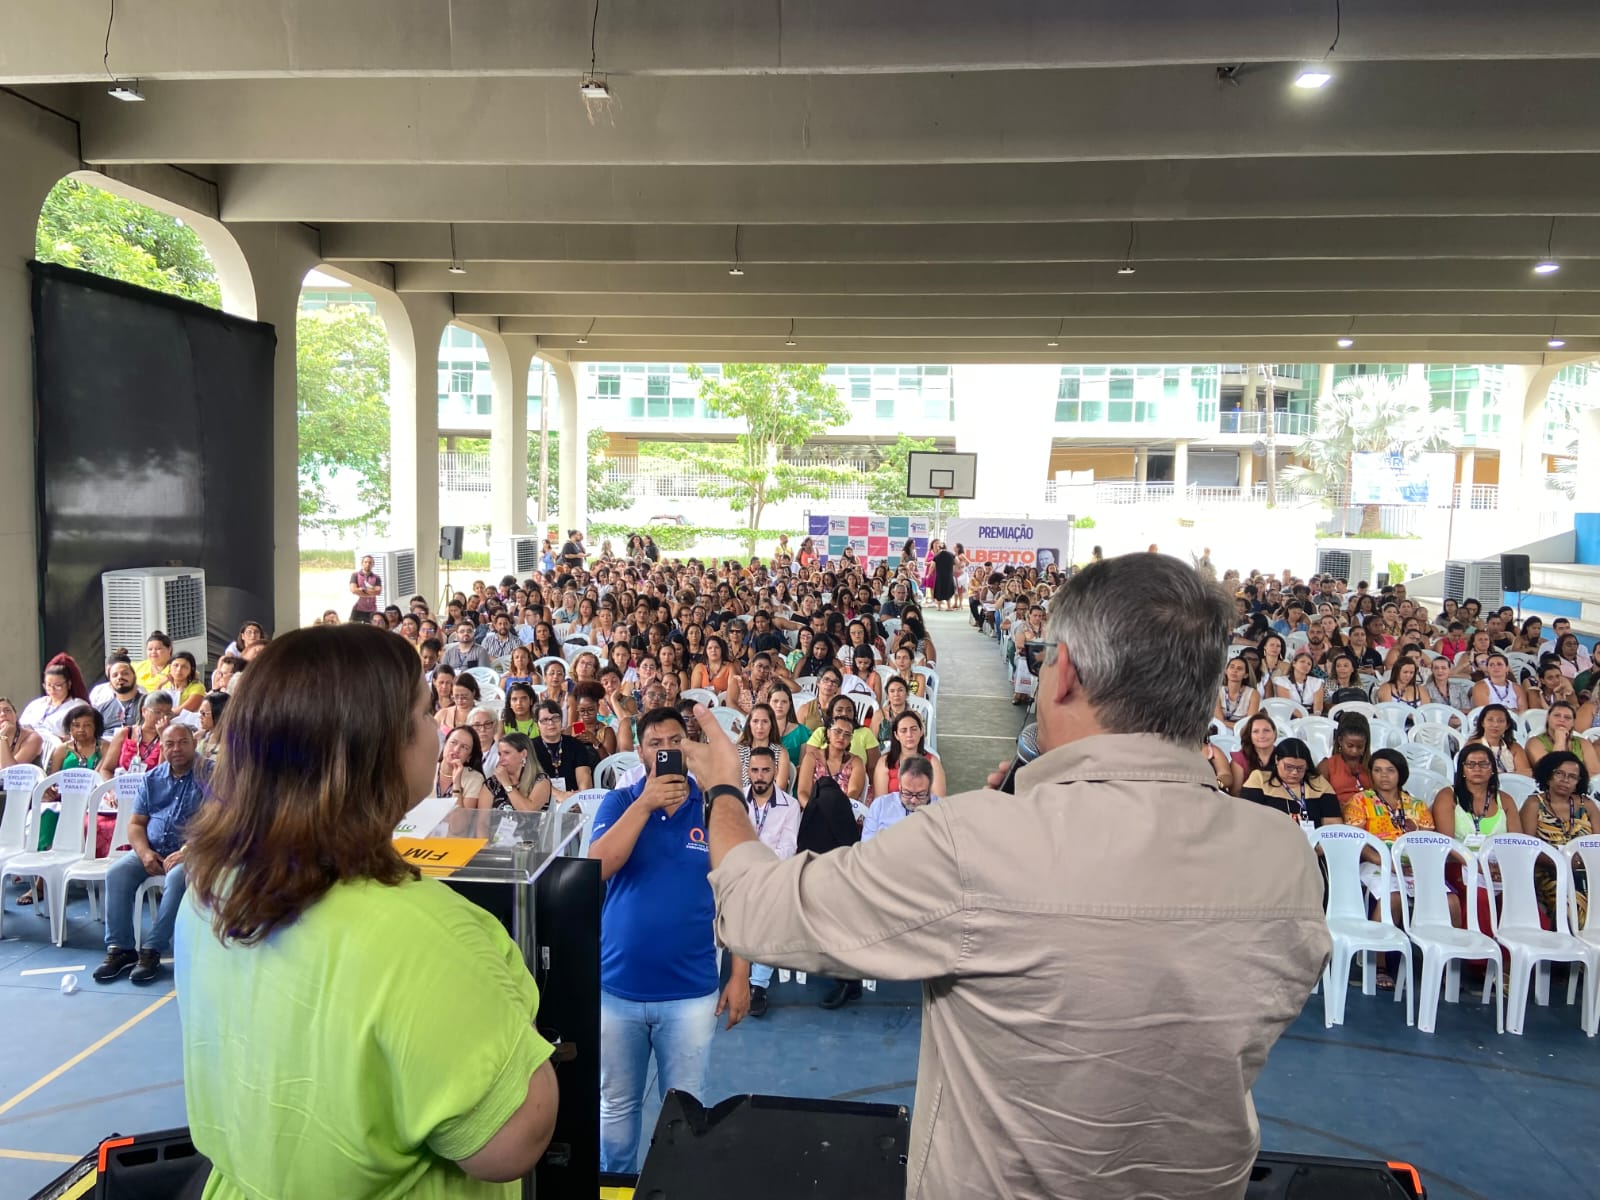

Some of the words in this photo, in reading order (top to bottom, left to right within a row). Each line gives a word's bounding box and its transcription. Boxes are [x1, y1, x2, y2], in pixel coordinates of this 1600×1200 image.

[979, 524, 1033, 542] PREMIAÇÃO
[965, 549, 1035, 564] LBERTO
[1494, 838, 1540, 846] RESERVADO
[402, 848, 449, 861] FIM
